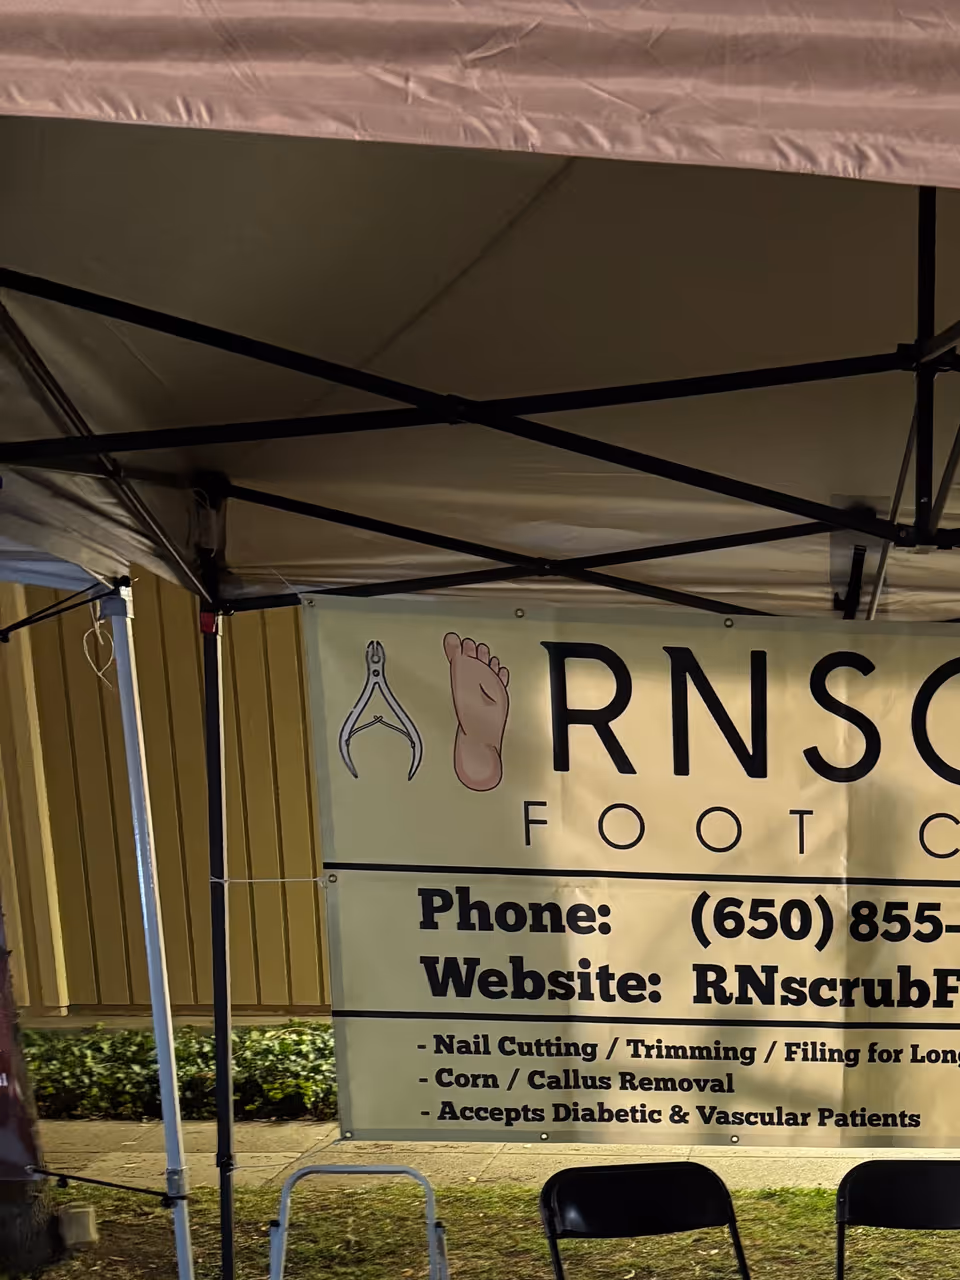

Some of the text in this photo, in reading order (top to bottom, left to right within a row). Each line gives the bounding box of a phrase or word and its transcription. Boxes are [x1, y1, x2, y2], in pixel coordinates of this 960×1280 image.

[523, 801, 814, 855] FOOT
[417, 886, 612, 935] Phone:
[691, 891, 834, 951] (650)
[420, 955, 662, 1003] Website:
[433, 1034, 491, 1055] Nail
[497, 1036, 598, 1063] Cutting
[626, 1038, 757, 1066] Trimming
[784, 1042, 860, 1068] Filing
[867, 1042, 904, 1064] for
[434, 1067, 499, 1089] Corn
[527, 1069, 612, 1090] Callus
[618, 1071, 735, 1093] Removal
[436, 1101, 545, 1127] Accepts
[552, 1102, 662, 1124] Diabetic
[668, 1104, 690, 1125] &
[695, 1105, 811, 1127] Vascular
[817, 1107, 921, 1128] Patients
